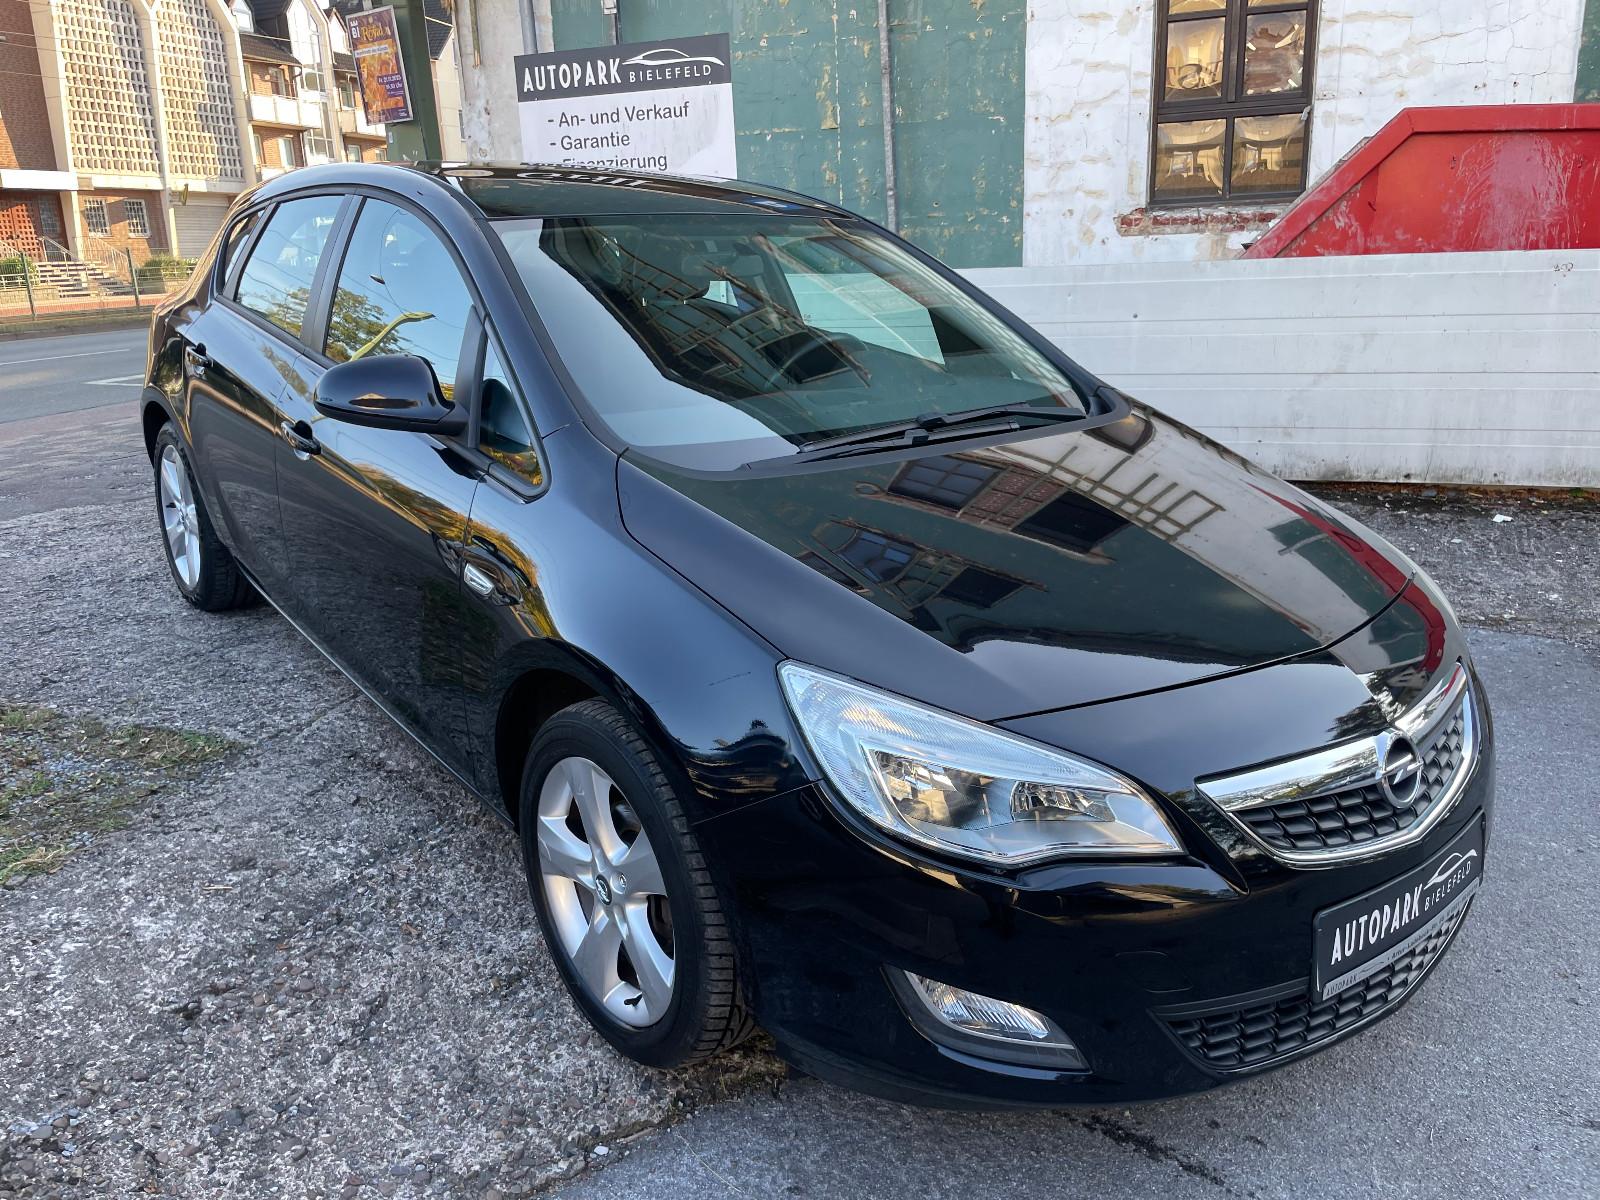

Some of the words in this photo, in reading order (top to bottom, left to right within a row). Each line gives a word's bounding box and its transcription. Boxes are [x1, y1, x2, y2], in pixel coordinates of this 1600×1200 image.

[523, 58, 622, 93] AUTOPARK
[629, 64, 712, 83] BIELEFELD
[558, 112, 585, 128] An-
[590, 108, 620, 125] und
[624, 101, 690, 121] Verkauf
[560, 131, 630, 151] Garantie
[1331, 883, 1422, 966] AUTOPARK
[1425, 861, 1471, 912] BIELEFELD
